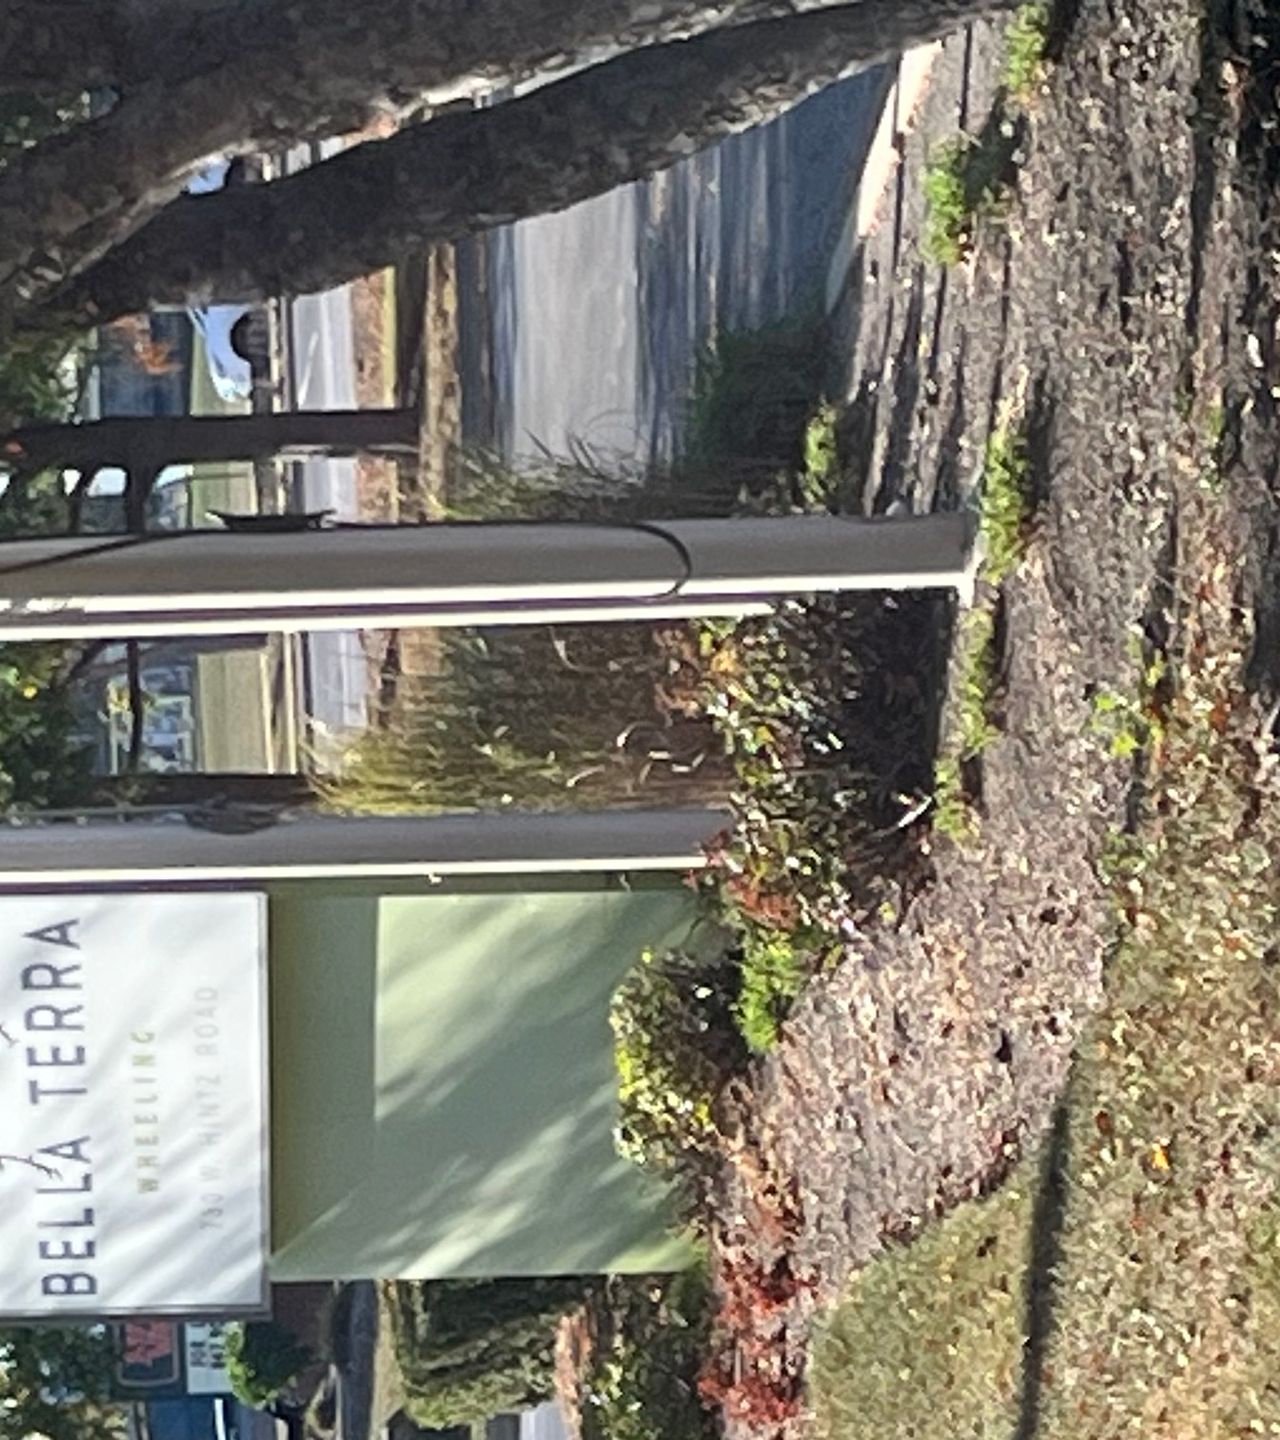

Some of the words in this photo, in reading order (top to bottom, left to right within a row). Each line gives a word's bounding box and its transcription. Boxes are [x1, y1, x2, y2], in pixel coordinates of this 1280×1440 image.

[21, 917, 87, 1105] TERRA
[193, 986, 219, 1058] ROAD
[130, 1031, 160, 1195] WHEELING
[193, 1075, 222, 1147] HINTZ
[37, 1134, 98, 1297] BELLA
